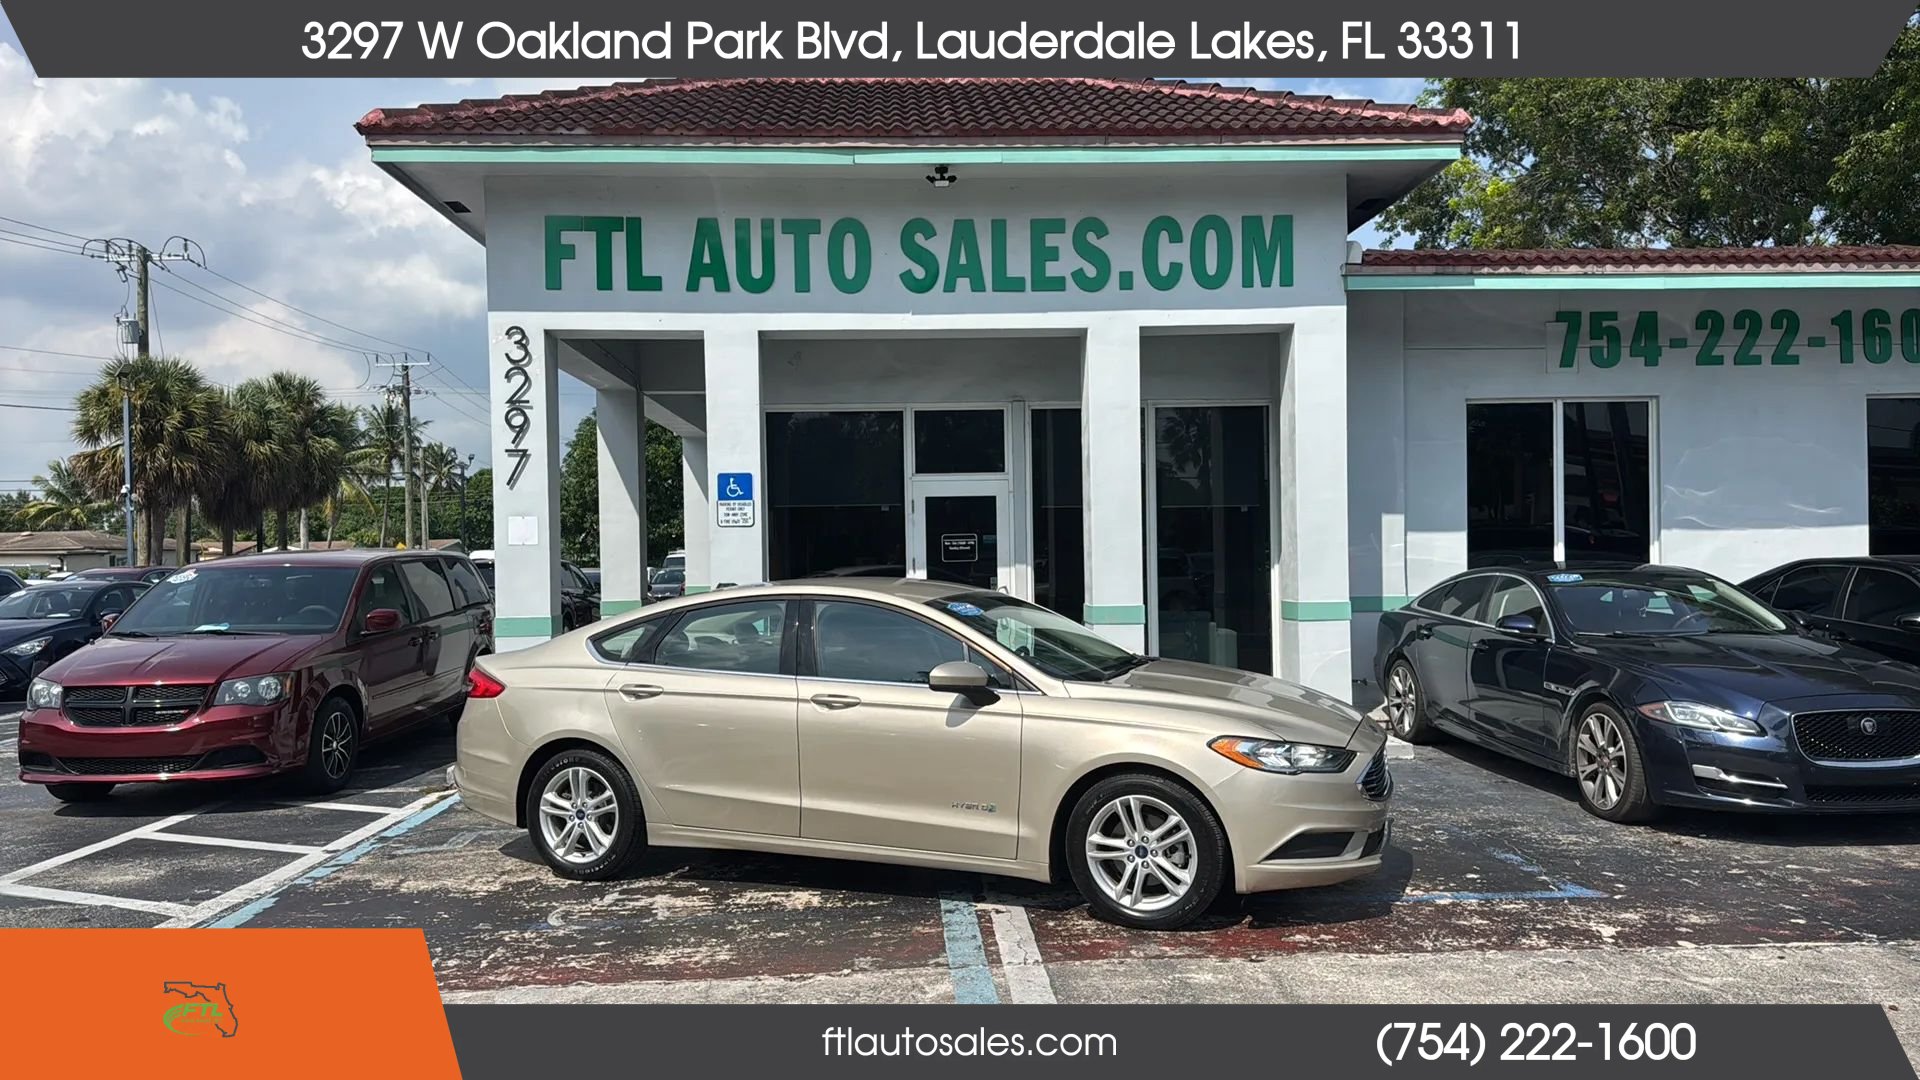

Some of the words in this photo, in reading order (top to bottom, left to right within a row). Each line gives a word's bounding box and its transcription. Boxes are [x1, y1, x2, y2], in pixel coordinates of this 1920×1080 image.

[544, 215, 663, 292] FTL
[685, 217, 873, 295] AUTO
[899, 214, 1296, 294] SALES.COM
[504, 325, 532, 488] 3297
